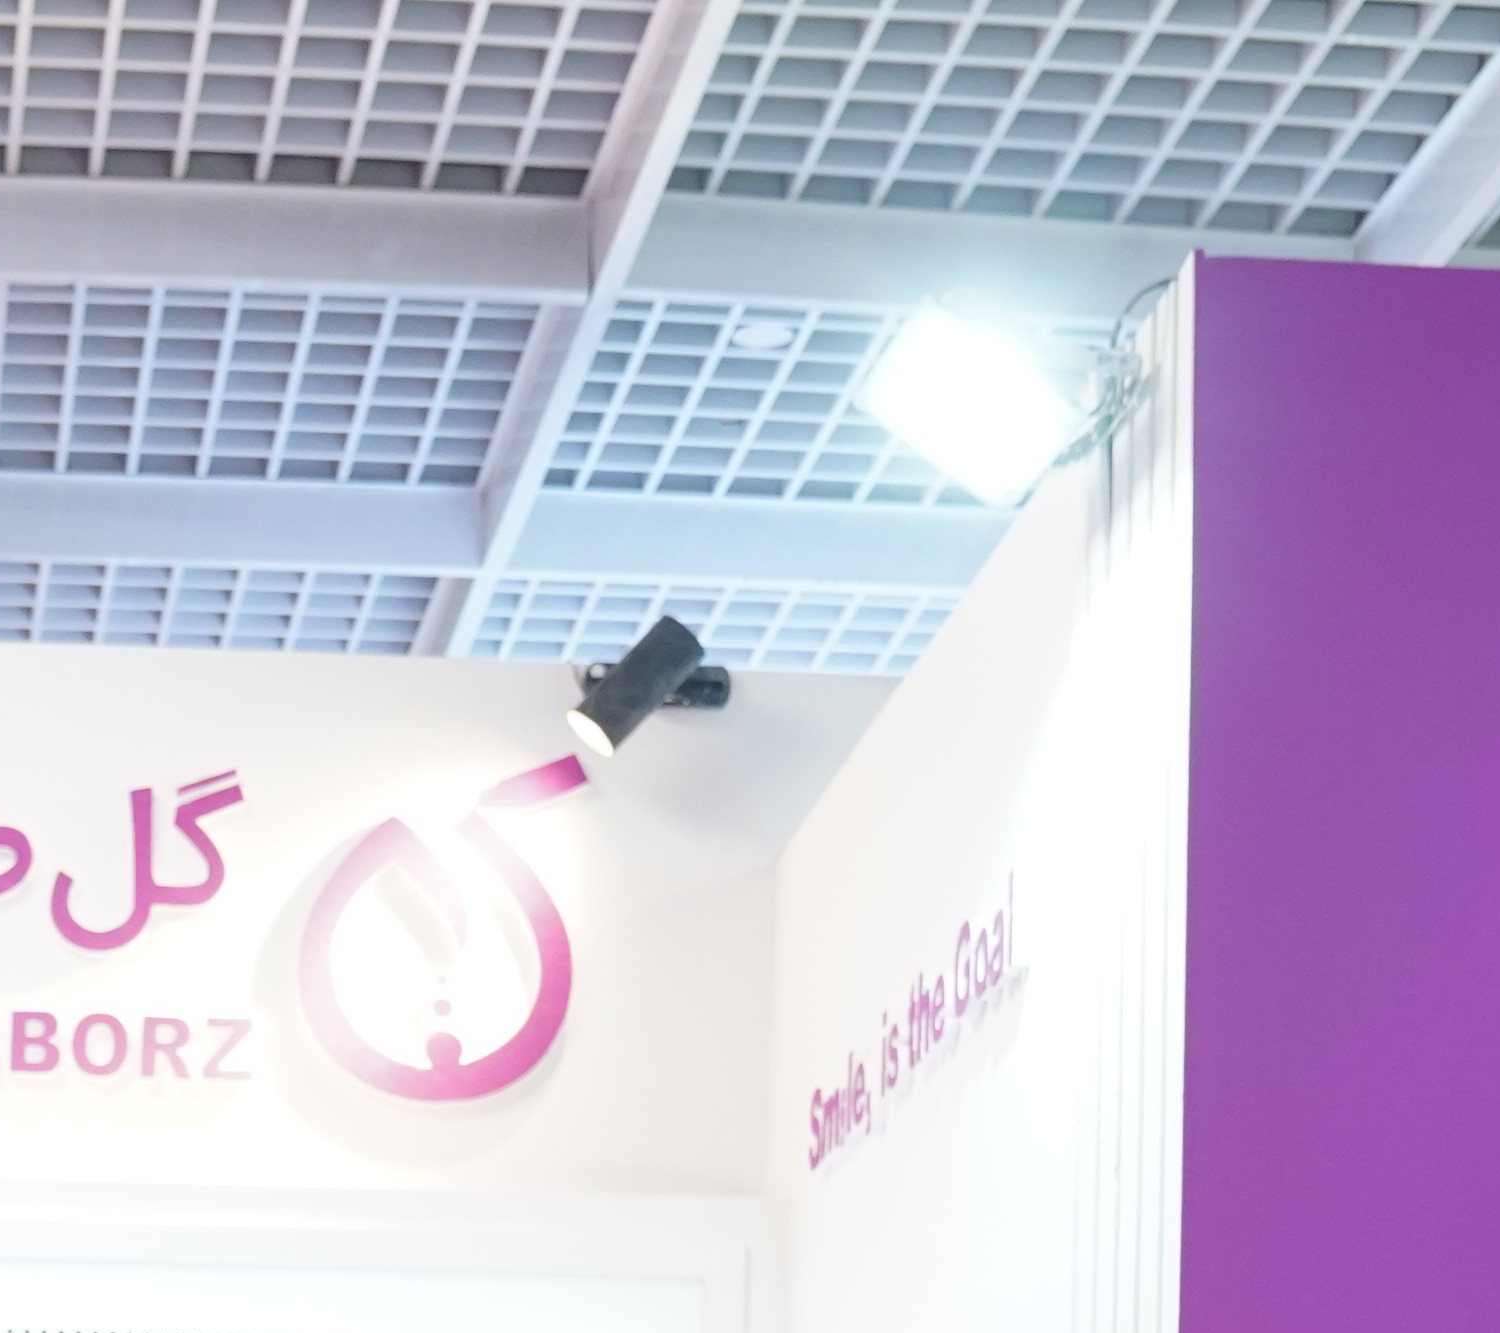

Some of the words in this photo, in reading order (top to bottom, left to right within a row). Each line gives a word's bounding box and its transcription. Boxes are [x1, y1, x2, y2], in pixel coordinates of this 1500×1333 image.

[50, 769, 244, 951] گل
[881, 1012, 899, 1096] is
[906, 972, 945, 1067] the
[955, 869, 1015, 1016] Goal
